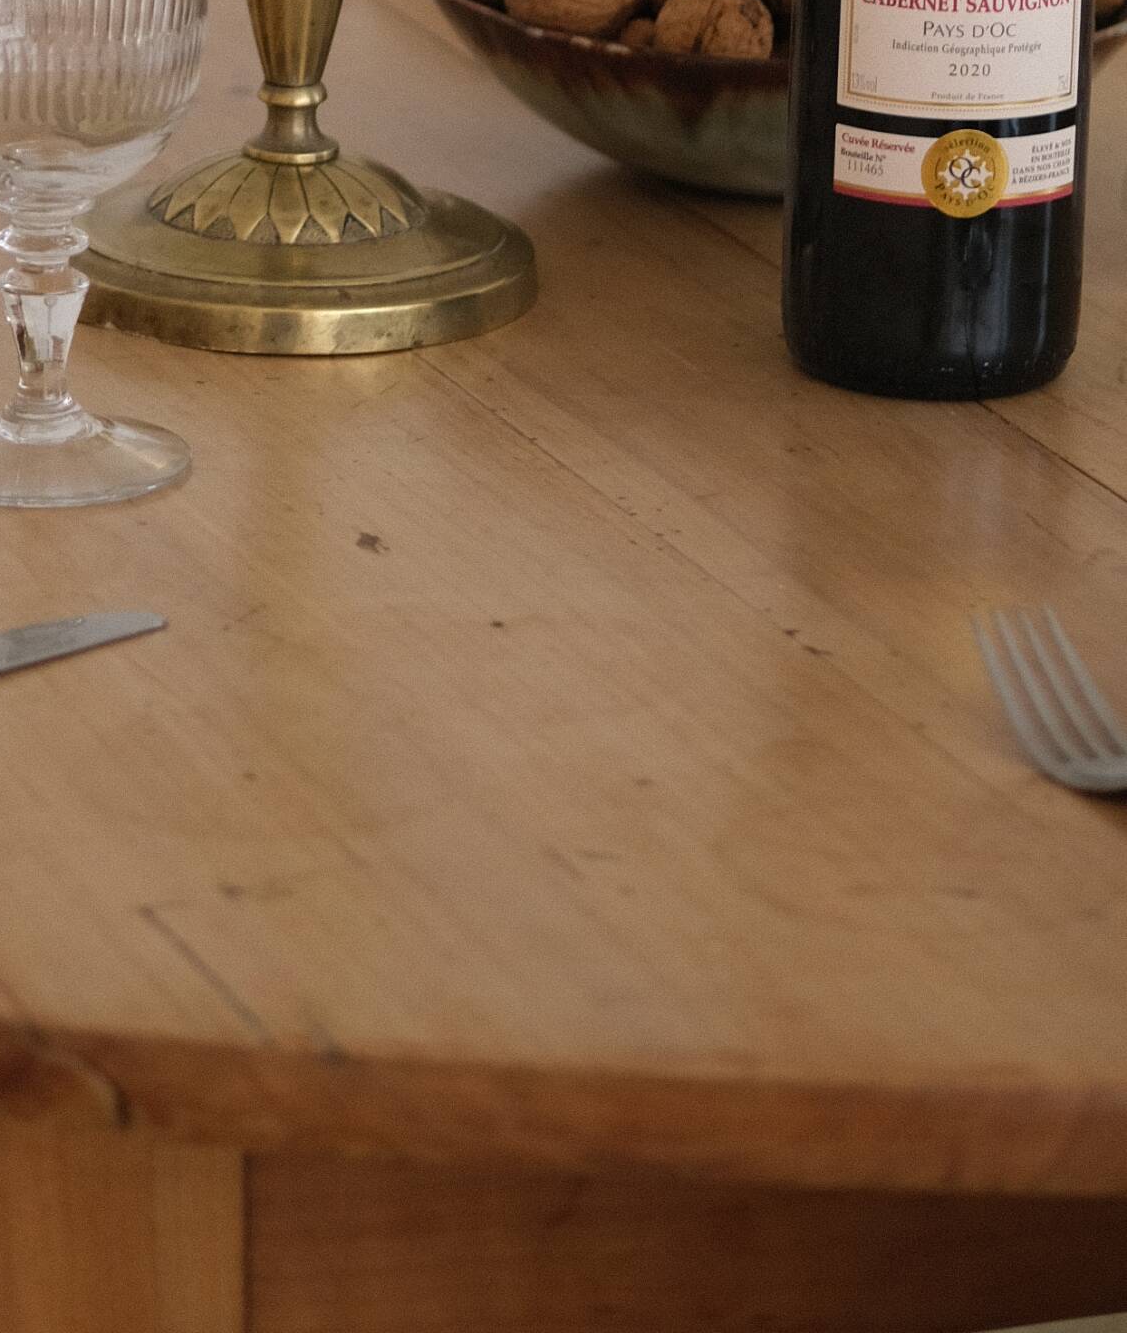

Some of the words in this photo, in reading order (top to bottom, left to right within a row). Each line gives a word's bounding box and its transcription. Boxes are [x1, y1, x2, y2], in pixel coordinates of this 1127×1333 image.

[923, 20, 965, 38] PAYS
[892, 39, 939, 53] Indication
[941, 43, 1006, 57] Géographique
[949, 63, 991, 77] 2020
[841, 132, 870, 147] Cuvée
